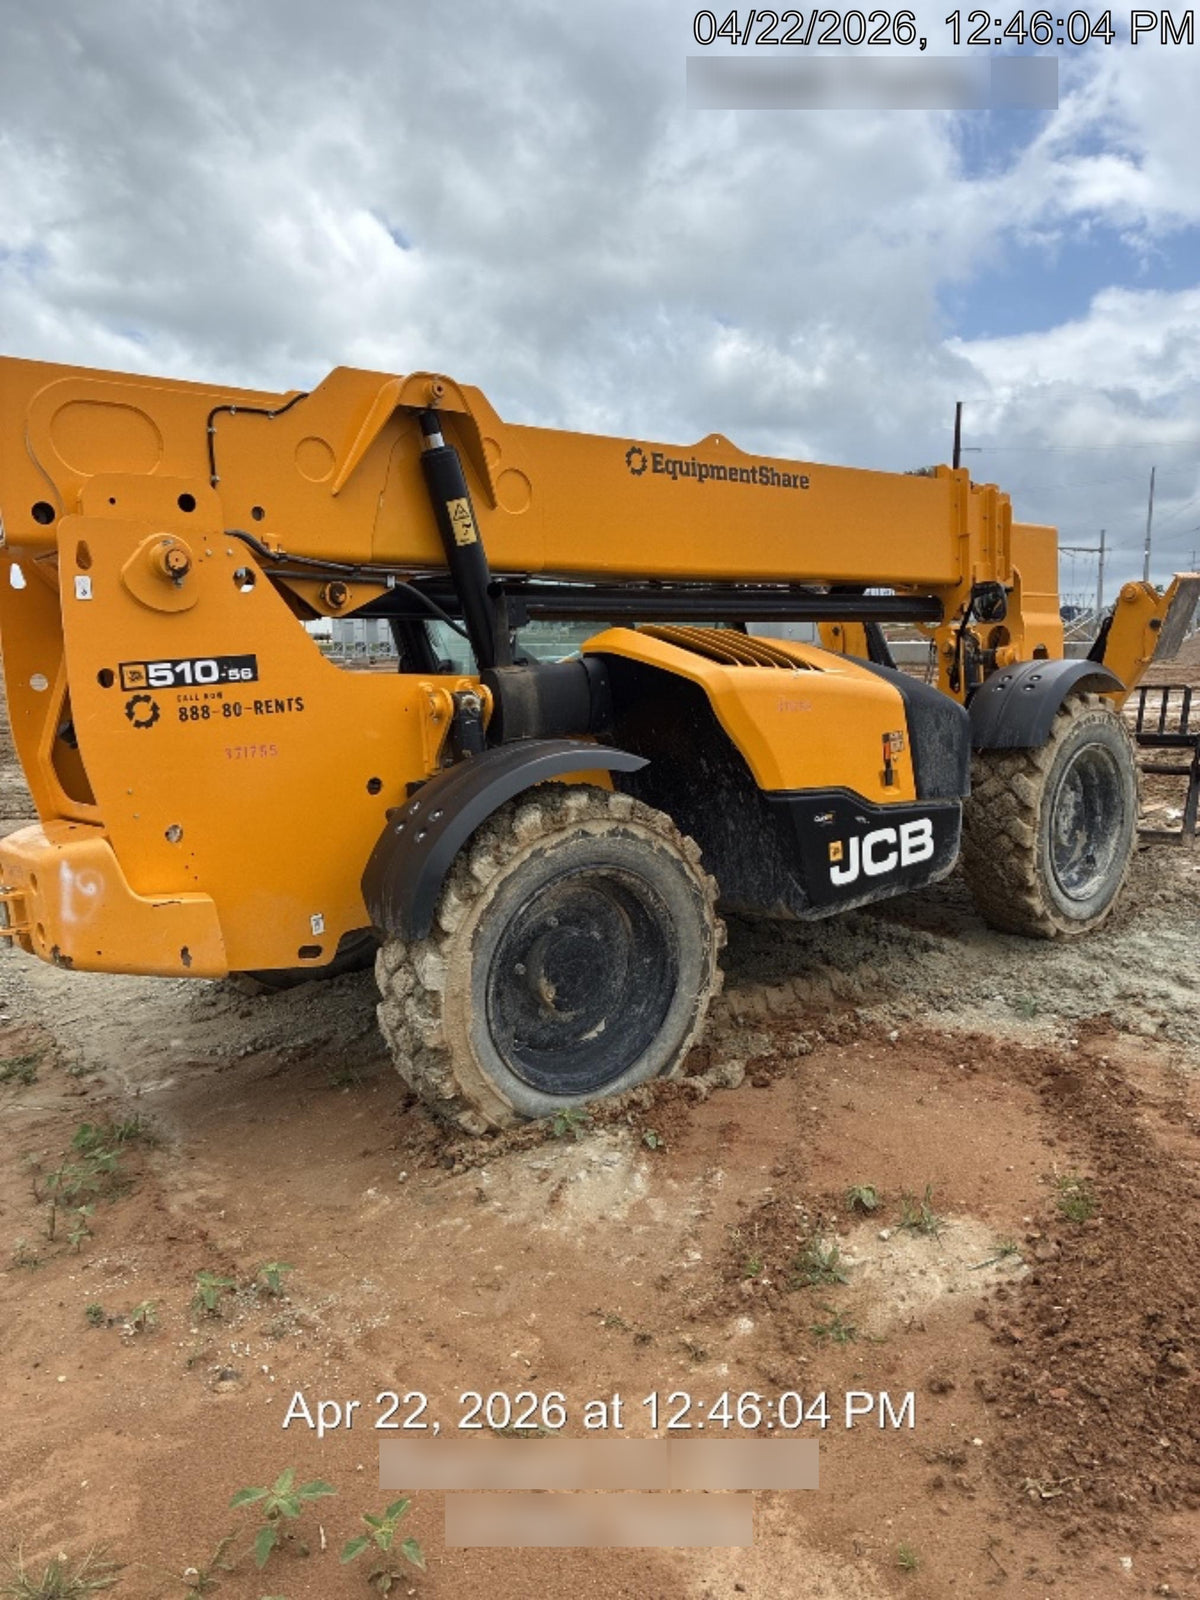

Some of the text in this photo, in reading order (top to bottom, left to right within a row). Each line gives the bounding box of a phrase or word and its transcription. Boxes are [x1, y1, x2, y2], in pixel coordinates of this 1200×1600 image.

[651, 452, 810, 489] EquipmentShare
[177, 693, 199, 702] CALL
[178, 696, 305, 721] 888-80-RENTS
[829, 817, 934, 886] JCB
